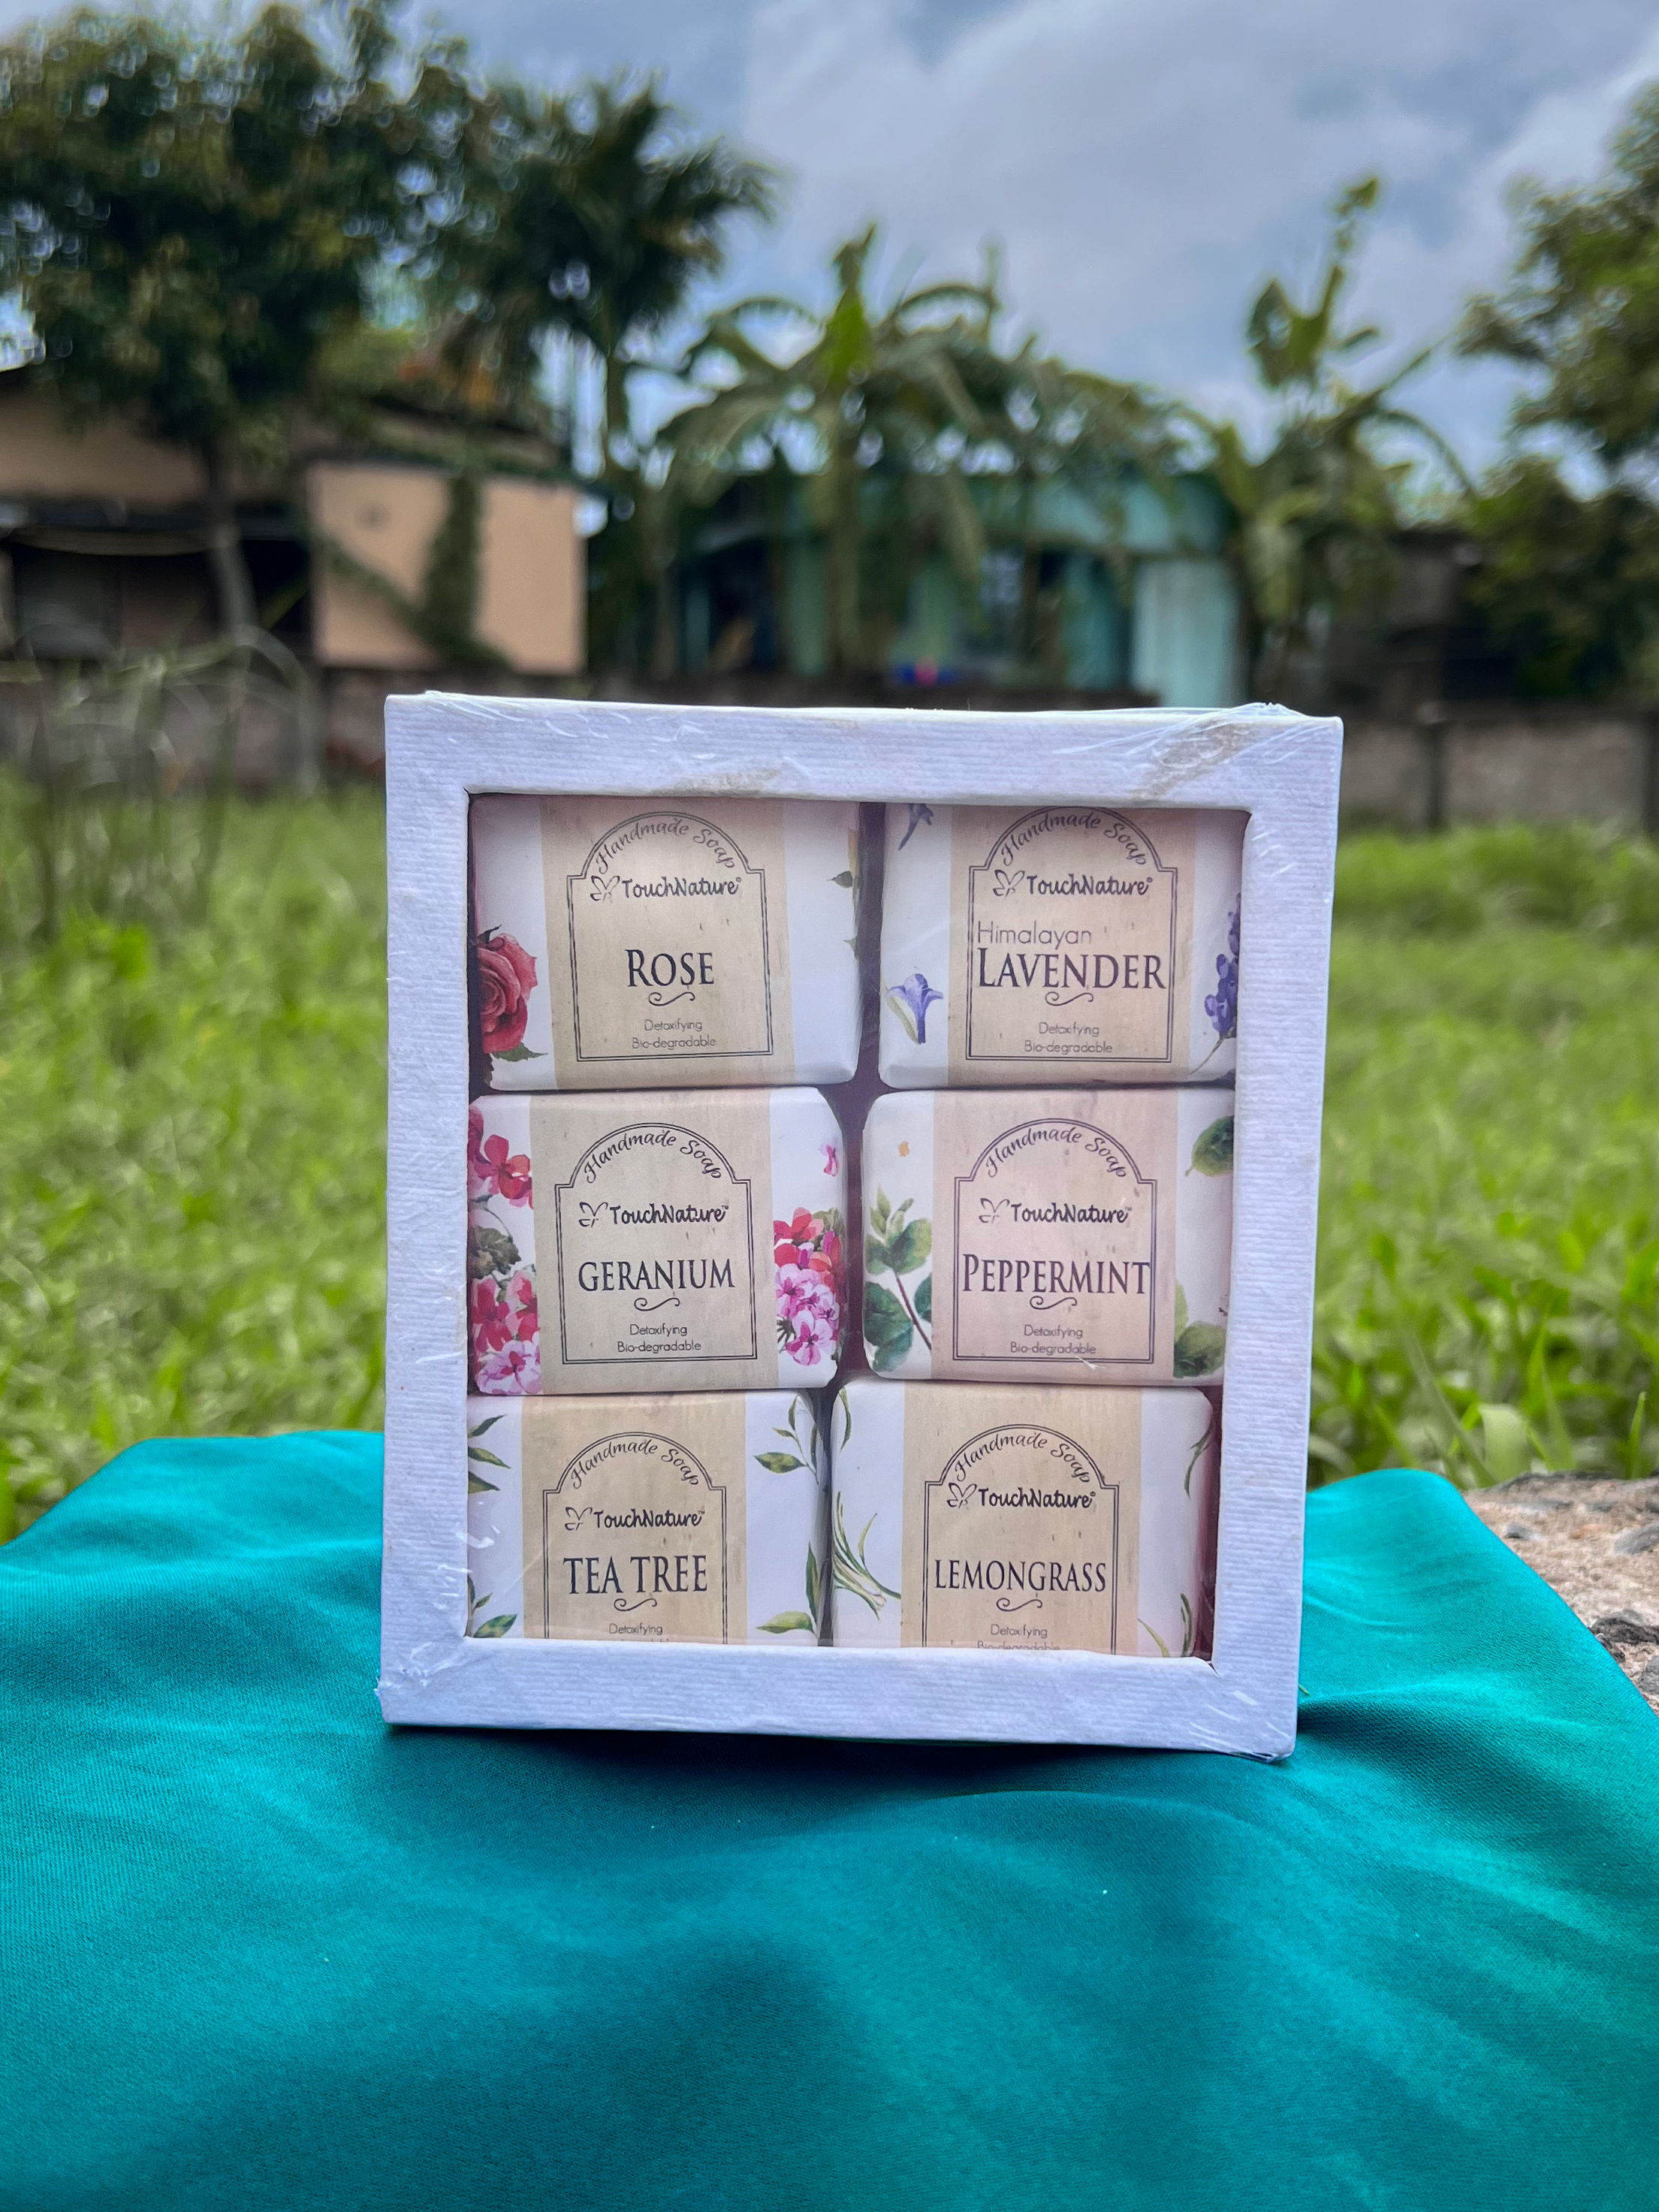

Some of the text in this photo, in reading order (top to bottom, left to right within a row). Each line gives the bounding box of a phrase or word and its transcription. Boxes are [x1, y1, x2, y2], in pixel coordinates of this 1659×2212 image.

[596, 818, 735, 874] Handmade Soap
[1000, 812, 1147, 865] Handmade Soap
[978, 920, 1092, 949] Himalayan
[624, 949, 715, 988] ROSE
[977, 947, 1167, 990] LAVENDER
[644, 1018, 703, 1033] Detoxifying
[1039, 1022, 1100, 1037] Detoxifying
[632, 1036, 716, 1051] Bio-degradable
[1024, 1040, 1113, 1055] Bio-degradable
[584, 1128, 722, 1184] Handmade Soap
[985, 1126, 1127, 1178] Handmade Soap
[578, 1258, 735, 1292] GERANIUM
[961, 1253, 1151, 1295] PEPPERMINT
[617, 1340, 701, 1354] Bio-degradable
[629, 1323, 689, 1337] Detoxifying
[1024, 1323, 1084, 1338] Detoxifying
[1009, 1341, 1096, 1356] Bio-degradable
[570, 1438, 699, 1489] Handmade Soap
[955, 1430, 1090, 1483] Handmade Soap
[563, 1554, 708, 1595] TEA TREE
[934, 1559, 1107, 1593] LEMONGRASS
[608, 1622, 663, 1636] Detoxifying
[990, 1623, 1048, 1638] Detoxifying
